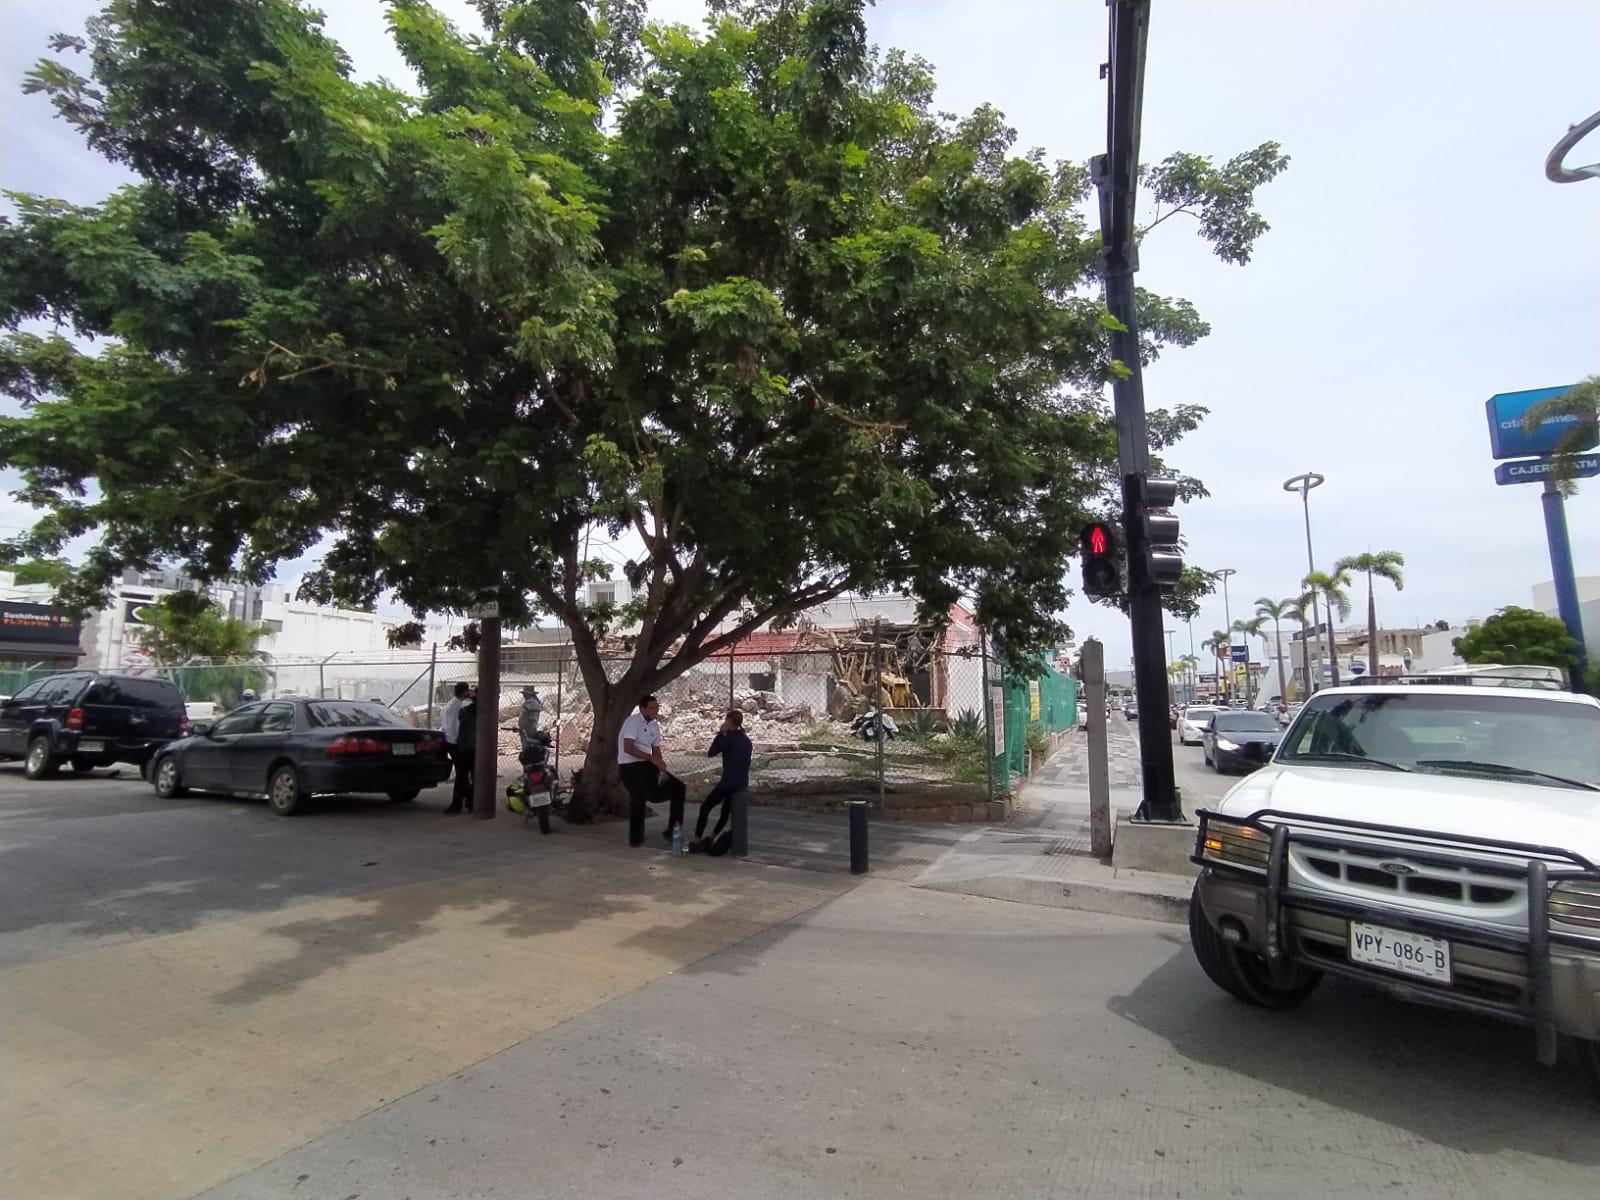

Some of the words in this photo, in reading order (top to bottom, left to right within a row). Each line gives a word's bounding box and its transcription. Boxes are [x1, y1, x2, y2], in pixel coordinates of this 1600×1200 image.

[1509, 463, 1560, 476] CAJERO
[3, 612, 50, 622] Sushifresh
[1354, 932, 1446, 969] VPY-086-B
